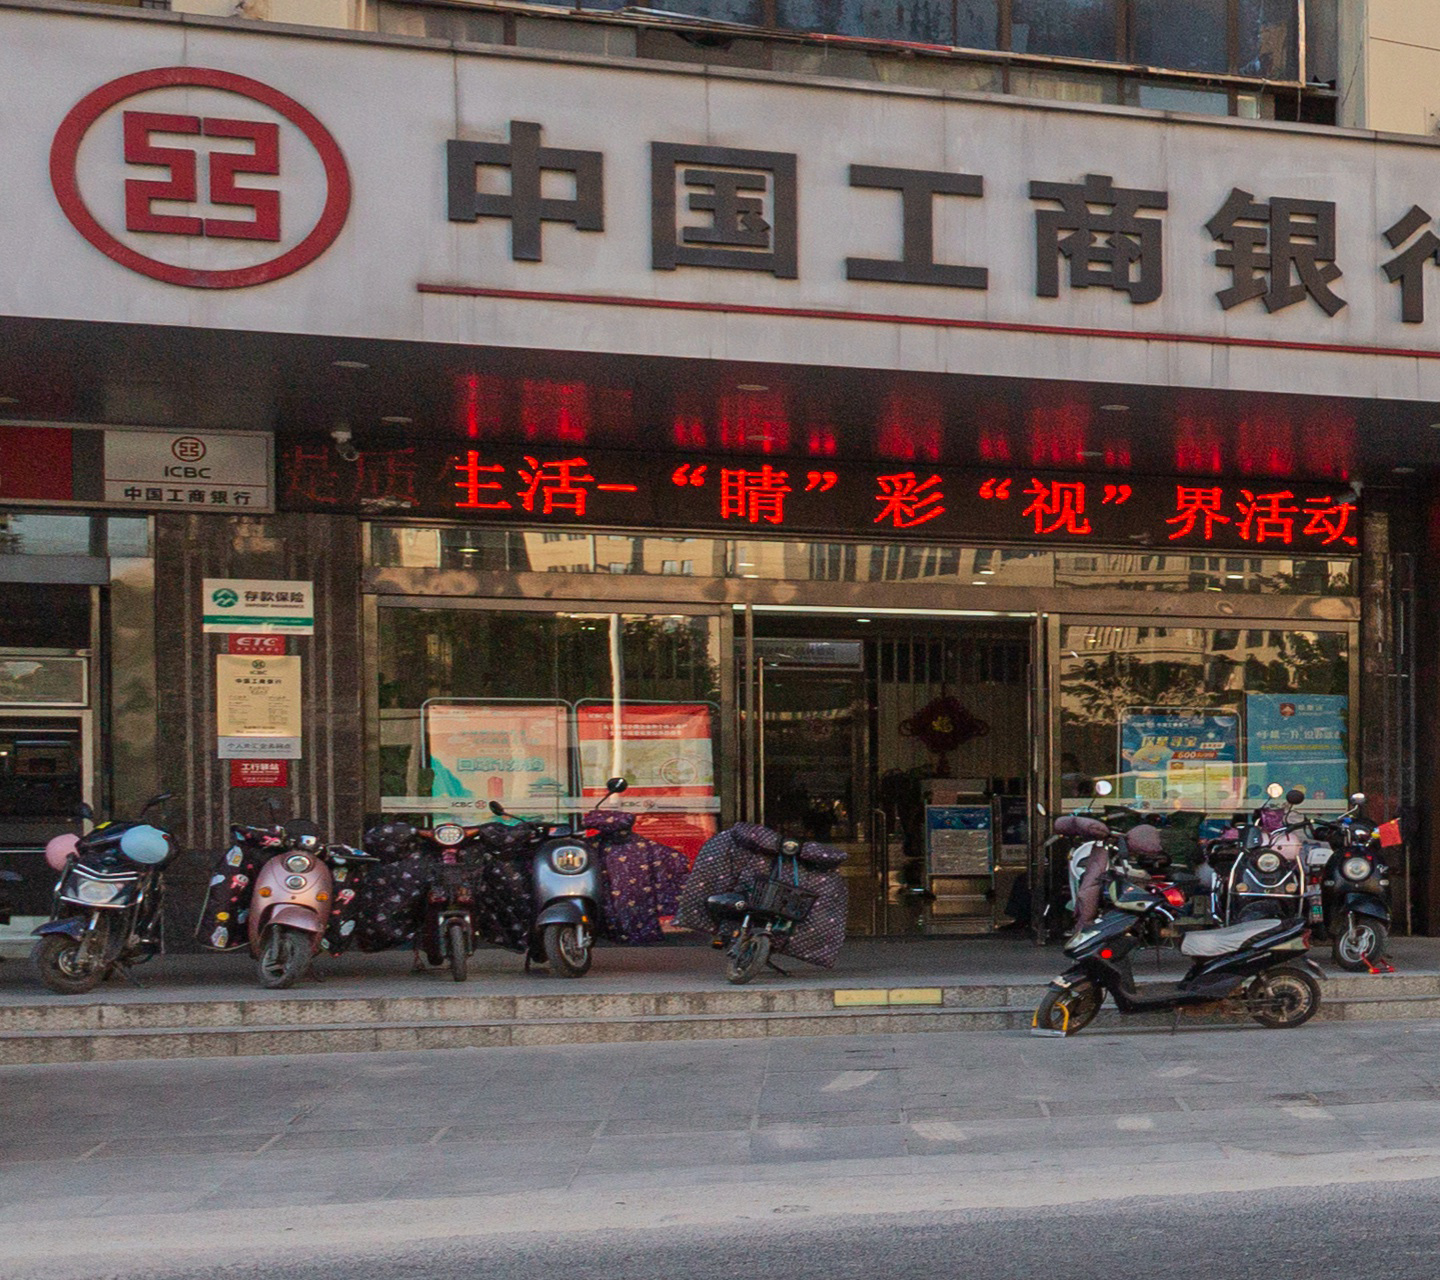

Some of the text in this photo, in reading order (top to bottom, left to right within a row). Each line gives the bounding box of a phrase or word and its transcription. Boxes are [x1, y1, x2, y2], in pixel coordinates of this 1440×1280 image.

[164, 466, 212, 479] ICBC
[124, 486, 251, 505] 中国工商银行
[244, 590, 305, 603] 存款保险
[236, 636, 279, 647] ETC
